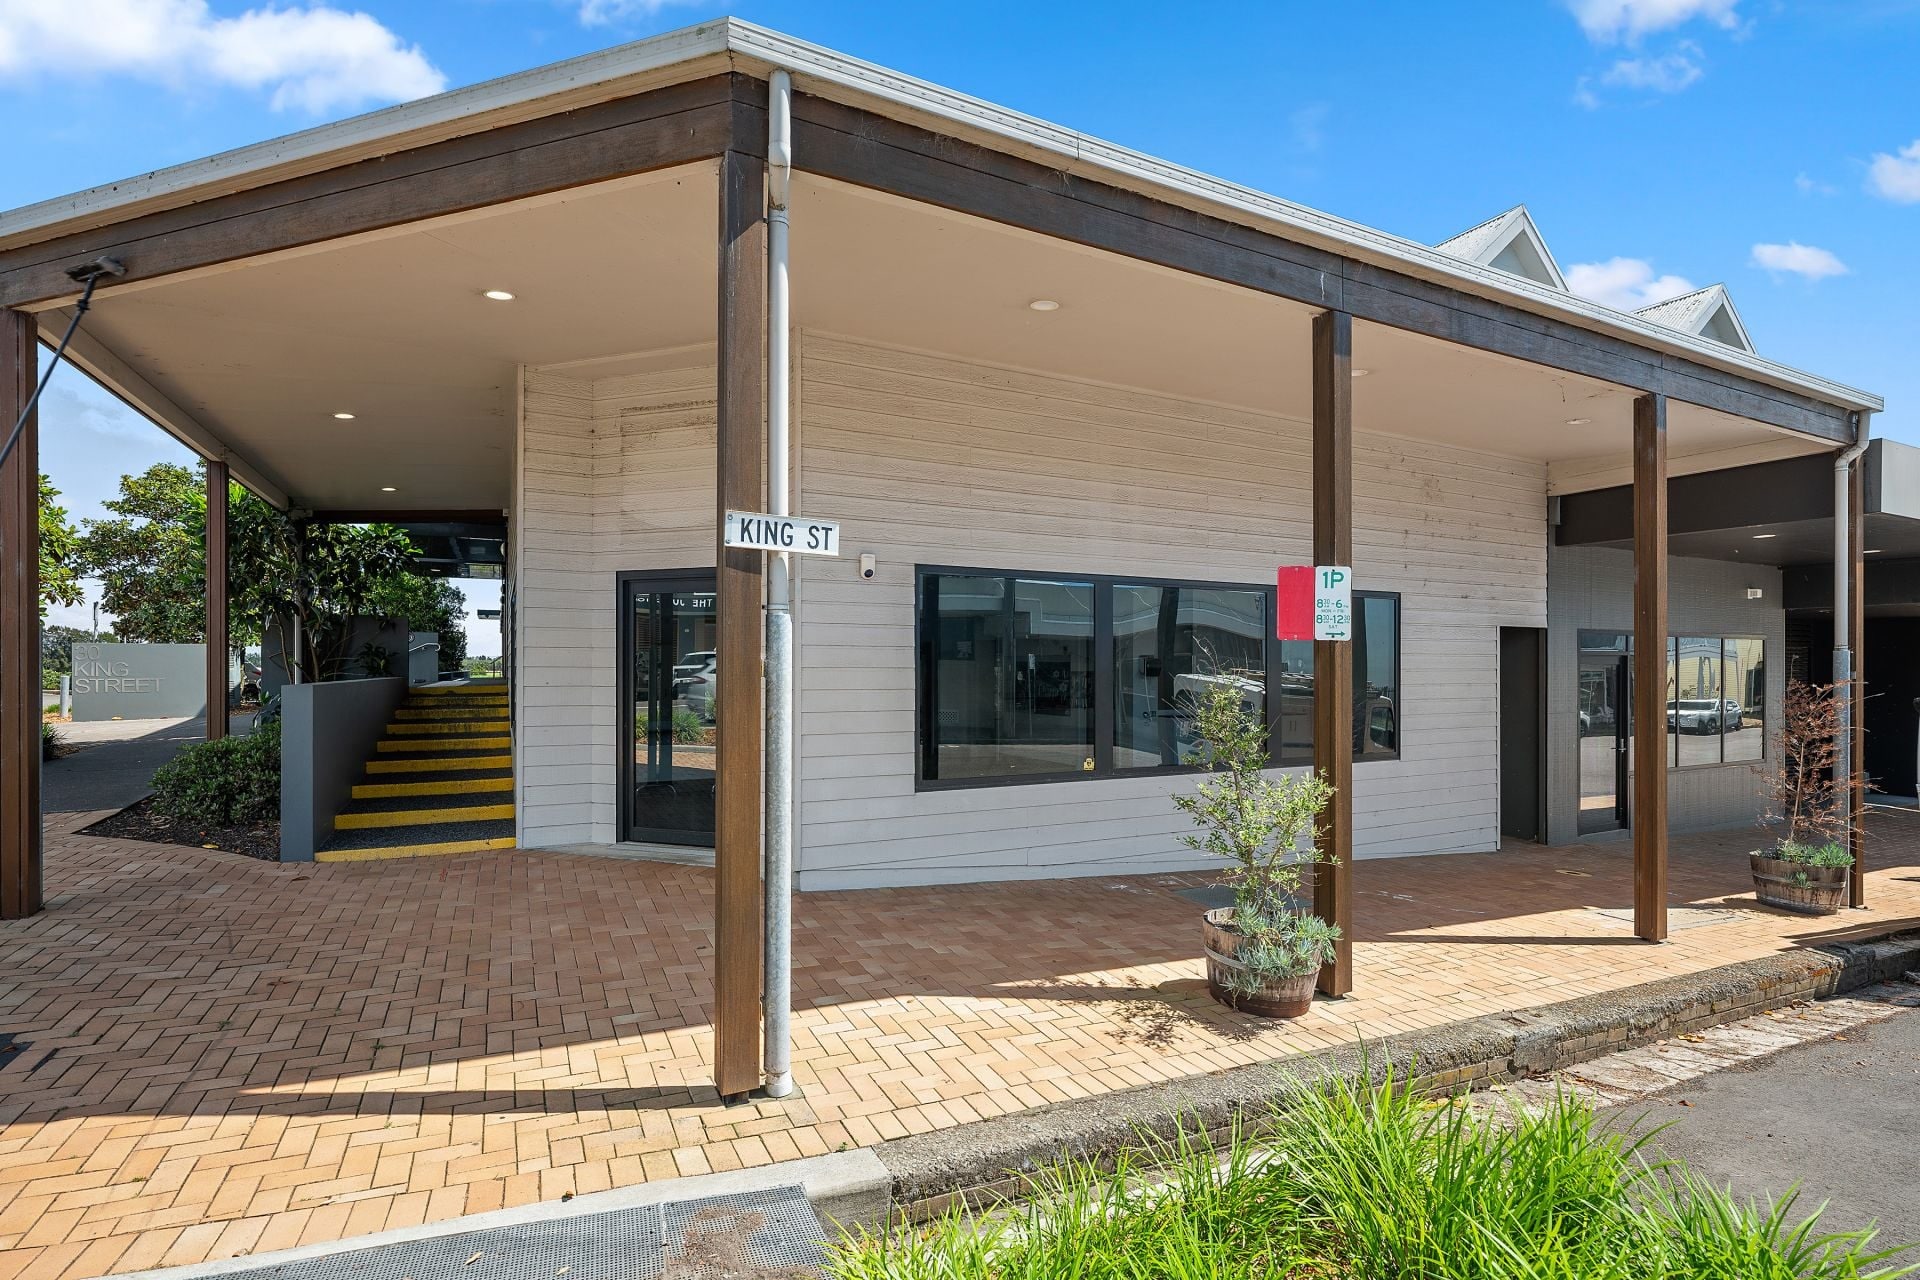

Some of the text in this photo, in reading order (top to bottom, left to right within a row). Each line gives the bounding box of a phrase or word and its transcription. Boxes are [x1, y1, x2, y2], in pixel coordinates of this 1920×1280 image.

[741, 518, 833, 550] KING ST
[1322, 572, 1344, 588] 1P
[74, 645, 99, 660] 30
[74, 661, 129, 677] KING
[74, 677, 166, 694] STREET
